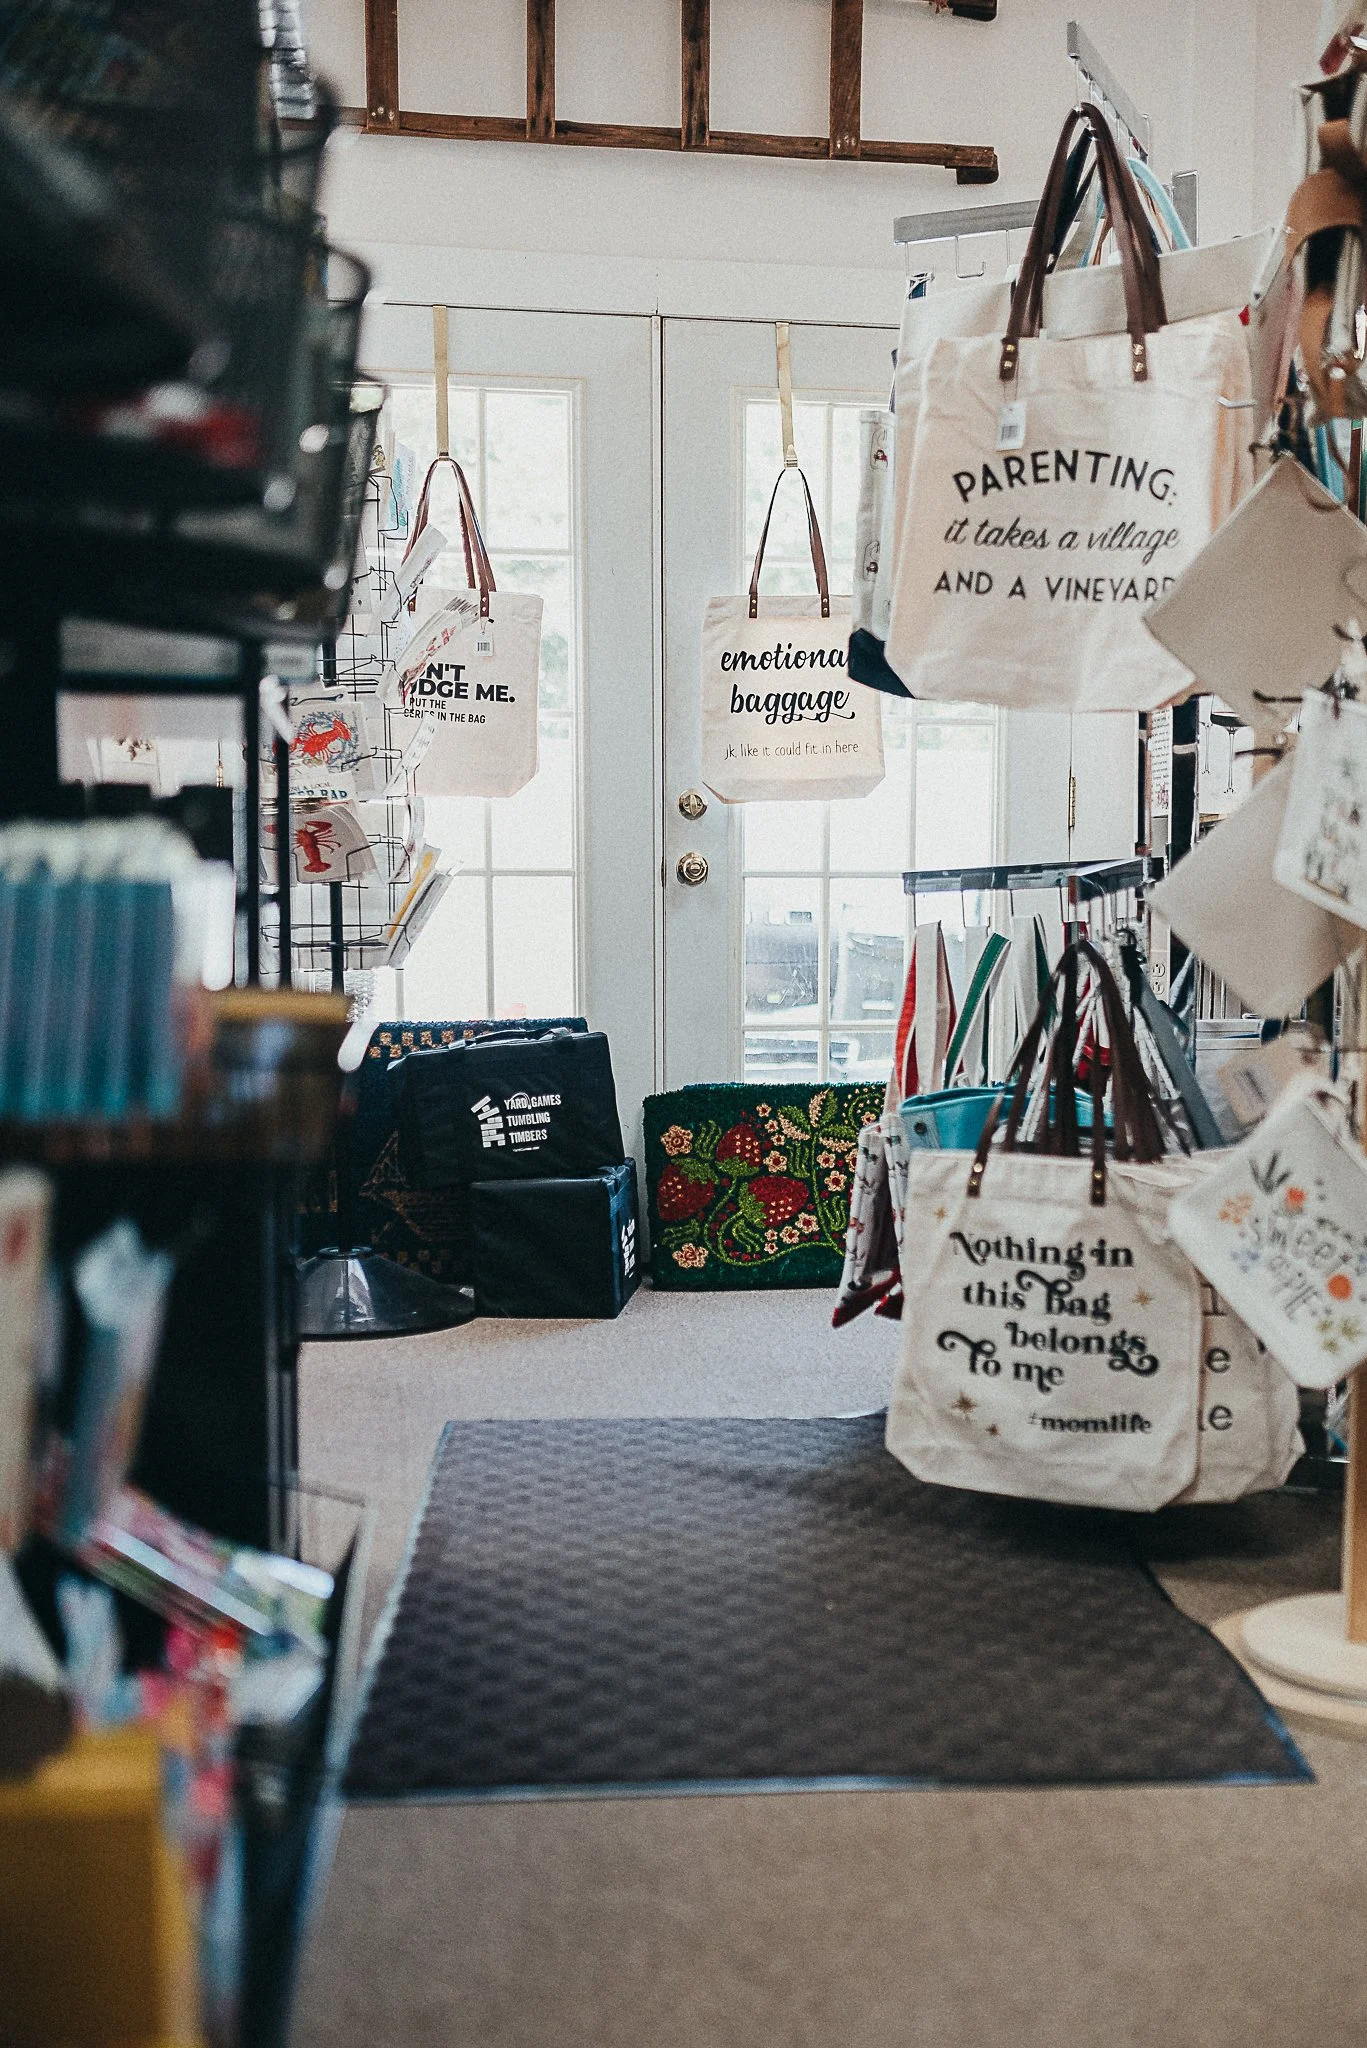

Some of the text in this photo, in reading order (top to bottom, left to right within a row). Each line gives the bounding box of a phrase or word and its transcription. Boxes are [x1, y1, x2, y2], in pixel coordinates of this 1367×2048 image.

[953, 449, 1177, 506] PARENTING:
[944, 517, 1181, 566] it takes a village
[933, 570, 994, 595] AND
[1008, 576, 1027, 599] A
[721, 643, 849, 671] emotiona
[420, 662, 466, 682] N'T
[409, 697, 446, 710] PUT THE
[410, 678, 516, 703] DGE ME.
[730, 683, 856, 725] baggage
[437, 711, 447, 721] IN
[449, 712, 466, 723] THE
[468, 714, 486, 724] BAG
[740, 743, 759, 757] like
[763, 745, 771, 756] it
[774, 742, 801, 756] could
[805, 742, 818, 755] fit
[823, 744, 832, 755] in
[836, 740, 859, 754] here
[506, 1111, 551, 1127] TUMBLING
[508, 1128, 548, 1144] TIMBERS
[949, 1231, 1134, 1282] Nothing in
[963, 1281, 1026, 1311] this
[1004, 1321, 1159, 1377] belongs
[1013, 1361, 1065, 1395] me
[1027, 1411, 1153, 1435] #momlife
